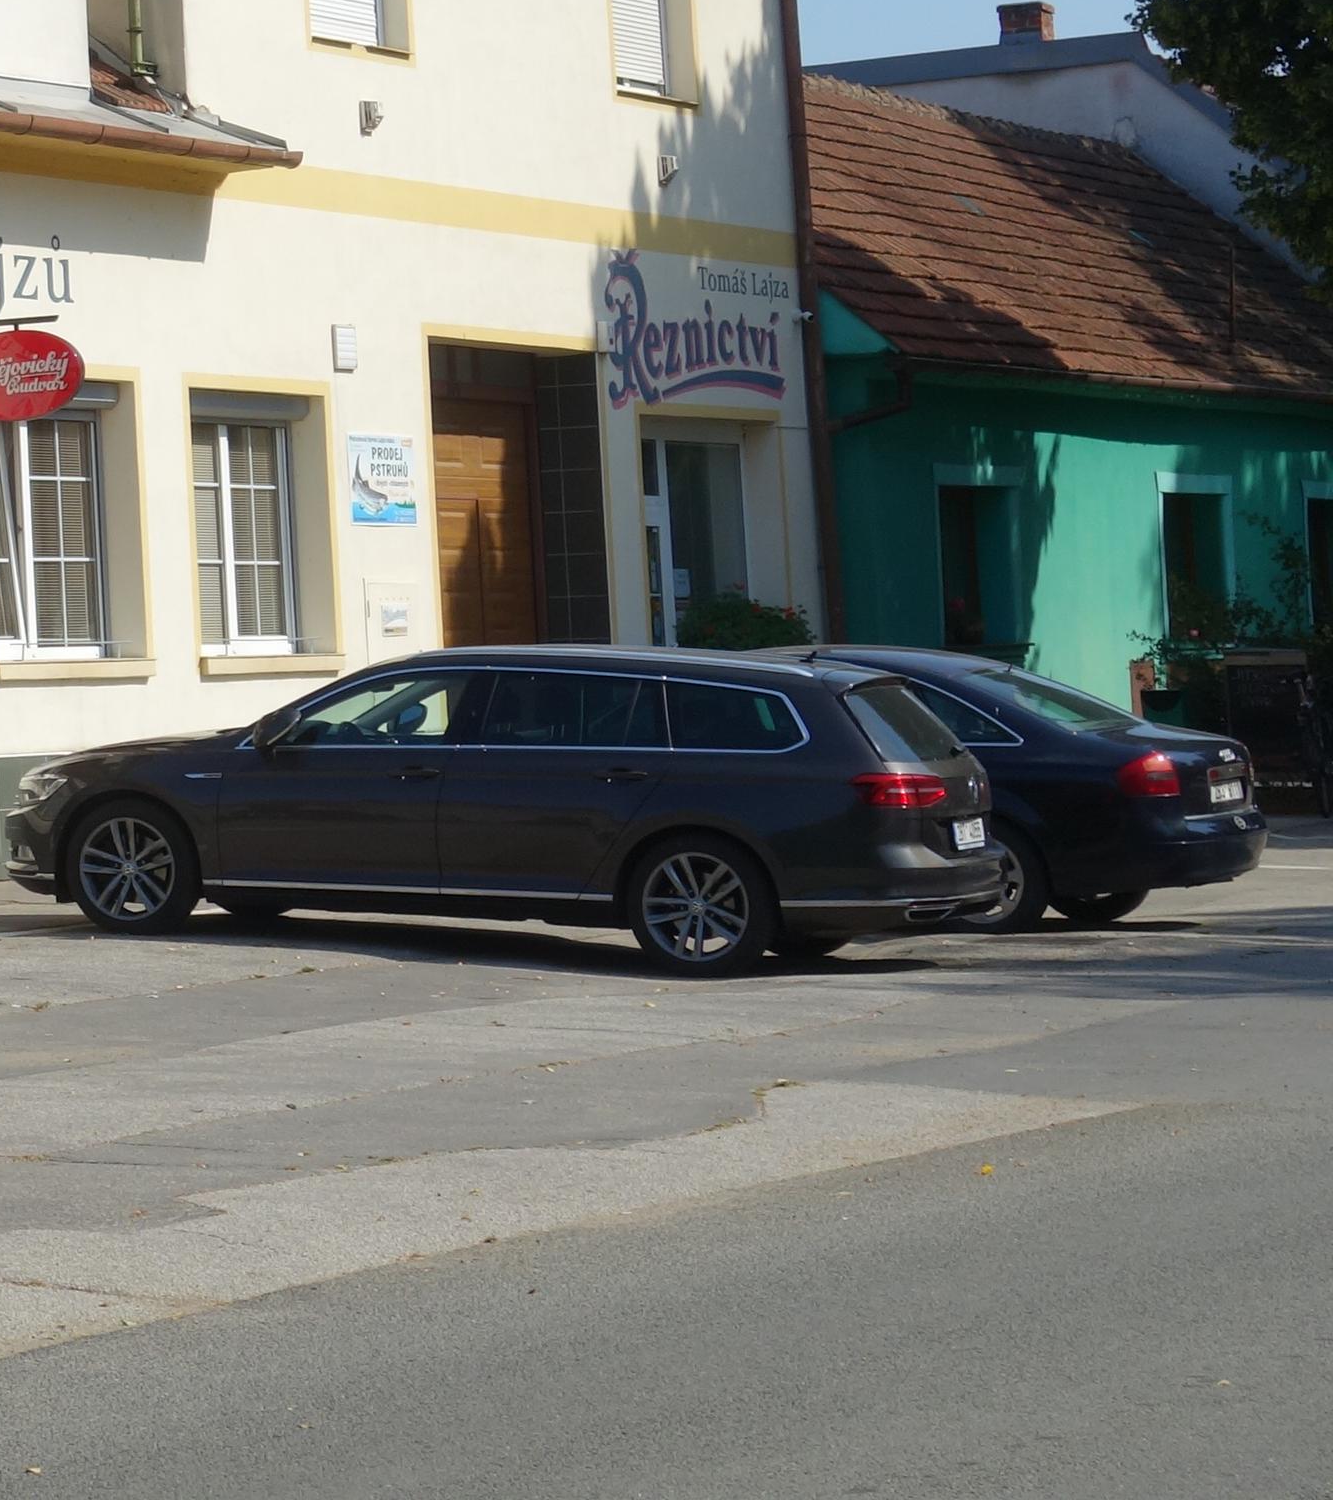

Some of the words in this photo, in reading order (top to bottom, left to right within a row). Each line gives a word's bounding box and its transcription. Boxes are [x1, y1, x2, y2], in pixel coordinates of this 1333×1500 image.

[697, 265, 748, 296] Tomáš
[751, 271, 790, 304] Lajza
[604, 248, 781, 410] Řeznictví
[6, 376, 68, 396] Budvar
[371, 446, 403, 461] PRODEJ
[370, 461, 409, 478] PSTRUHŮ
